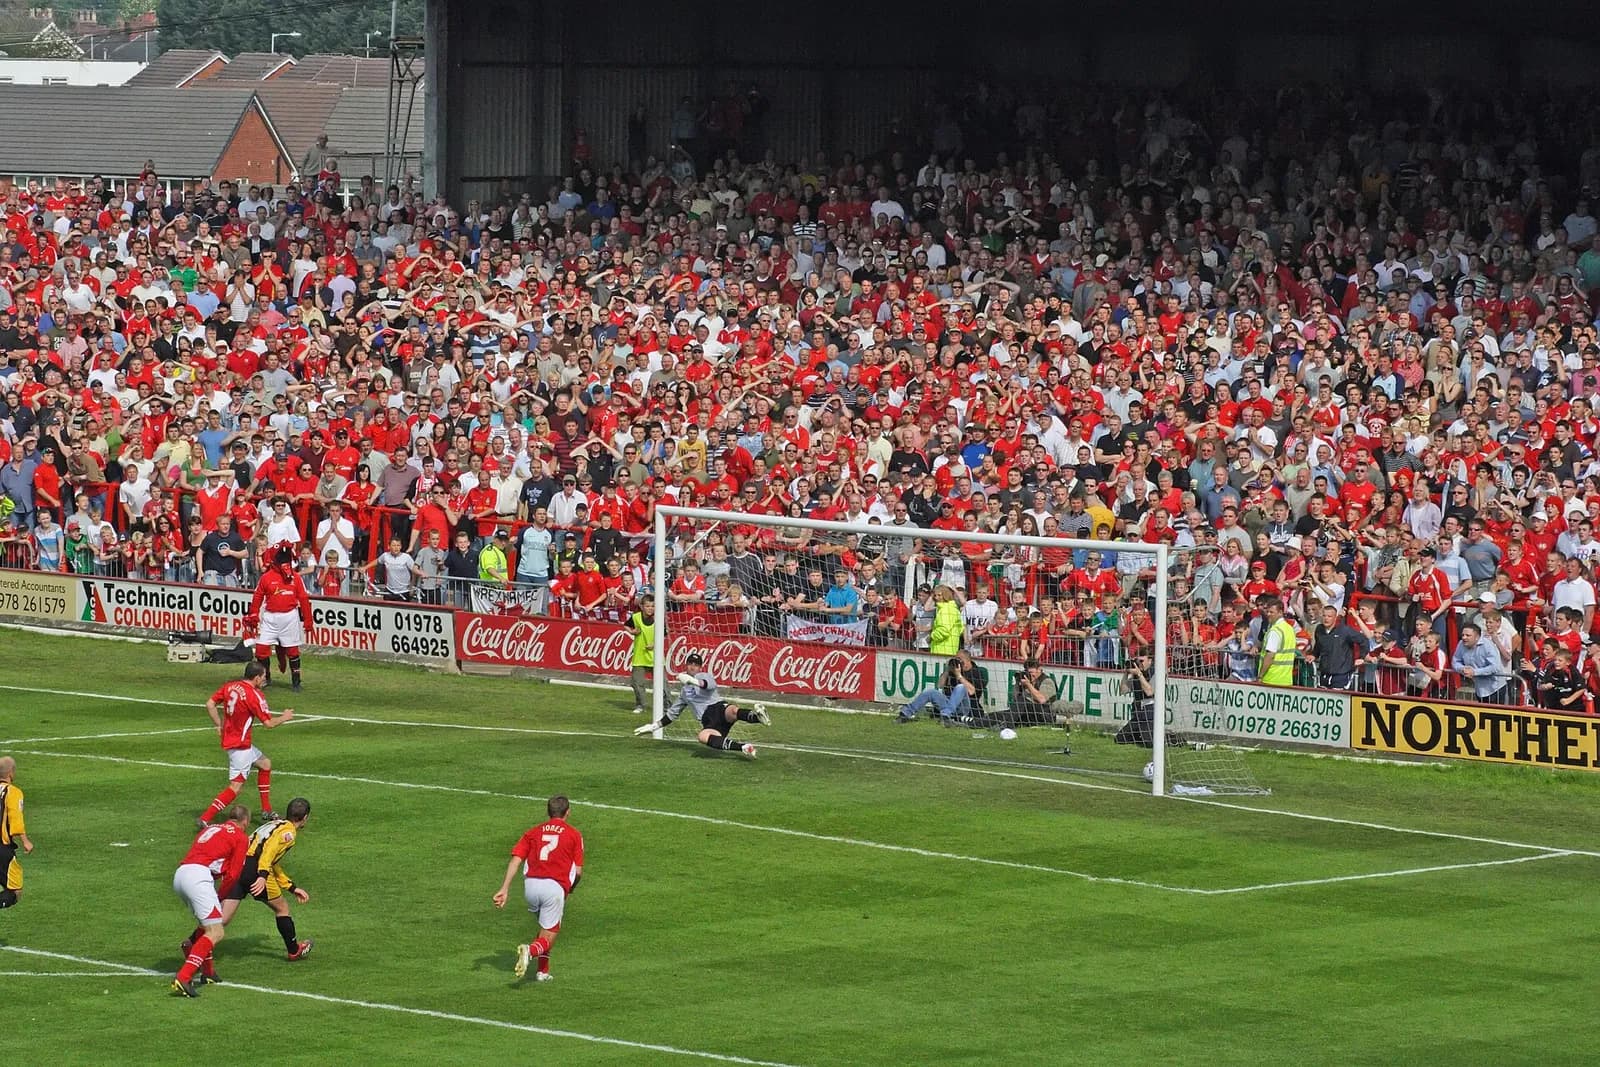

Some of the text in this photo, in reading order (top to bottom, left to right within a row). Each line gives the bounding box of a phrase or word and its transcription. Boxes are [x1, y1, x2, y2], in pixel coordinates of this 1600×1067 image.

[21, 580, 66, 594] Accountants
[89, 583, 97, 620] TCS
[22, 594, 66, 615] 261579
[103, 582, 193, 611] Technical
[200, 591, 251, 615] Colou
[353, 607, 382, 631] Ltd
[114, 606, 196, 633] COLOURING
[201, 614, 229, 635] THE
[305, 627, 378, 652] INDUSTRY
[394, 611, 443, 634] 01978
[462, 617, 550, 662] Coca-Cola
[391, 634, 450, 658] 664925
[560, 625, 633, 672] Coca-Col
[769, 646, 867, 695] Coca-Cola
[882, 658, 946, 699] JOH
[1190, 685, 1244, 709] GLAZING
[1247, 691, 1344, 718] CONTRACTORS
[1193, 709, 1342, 743] Tel: 01978 266319
[542, 824, 565, 834] JONES
[539, 834, 560, 861] 7
